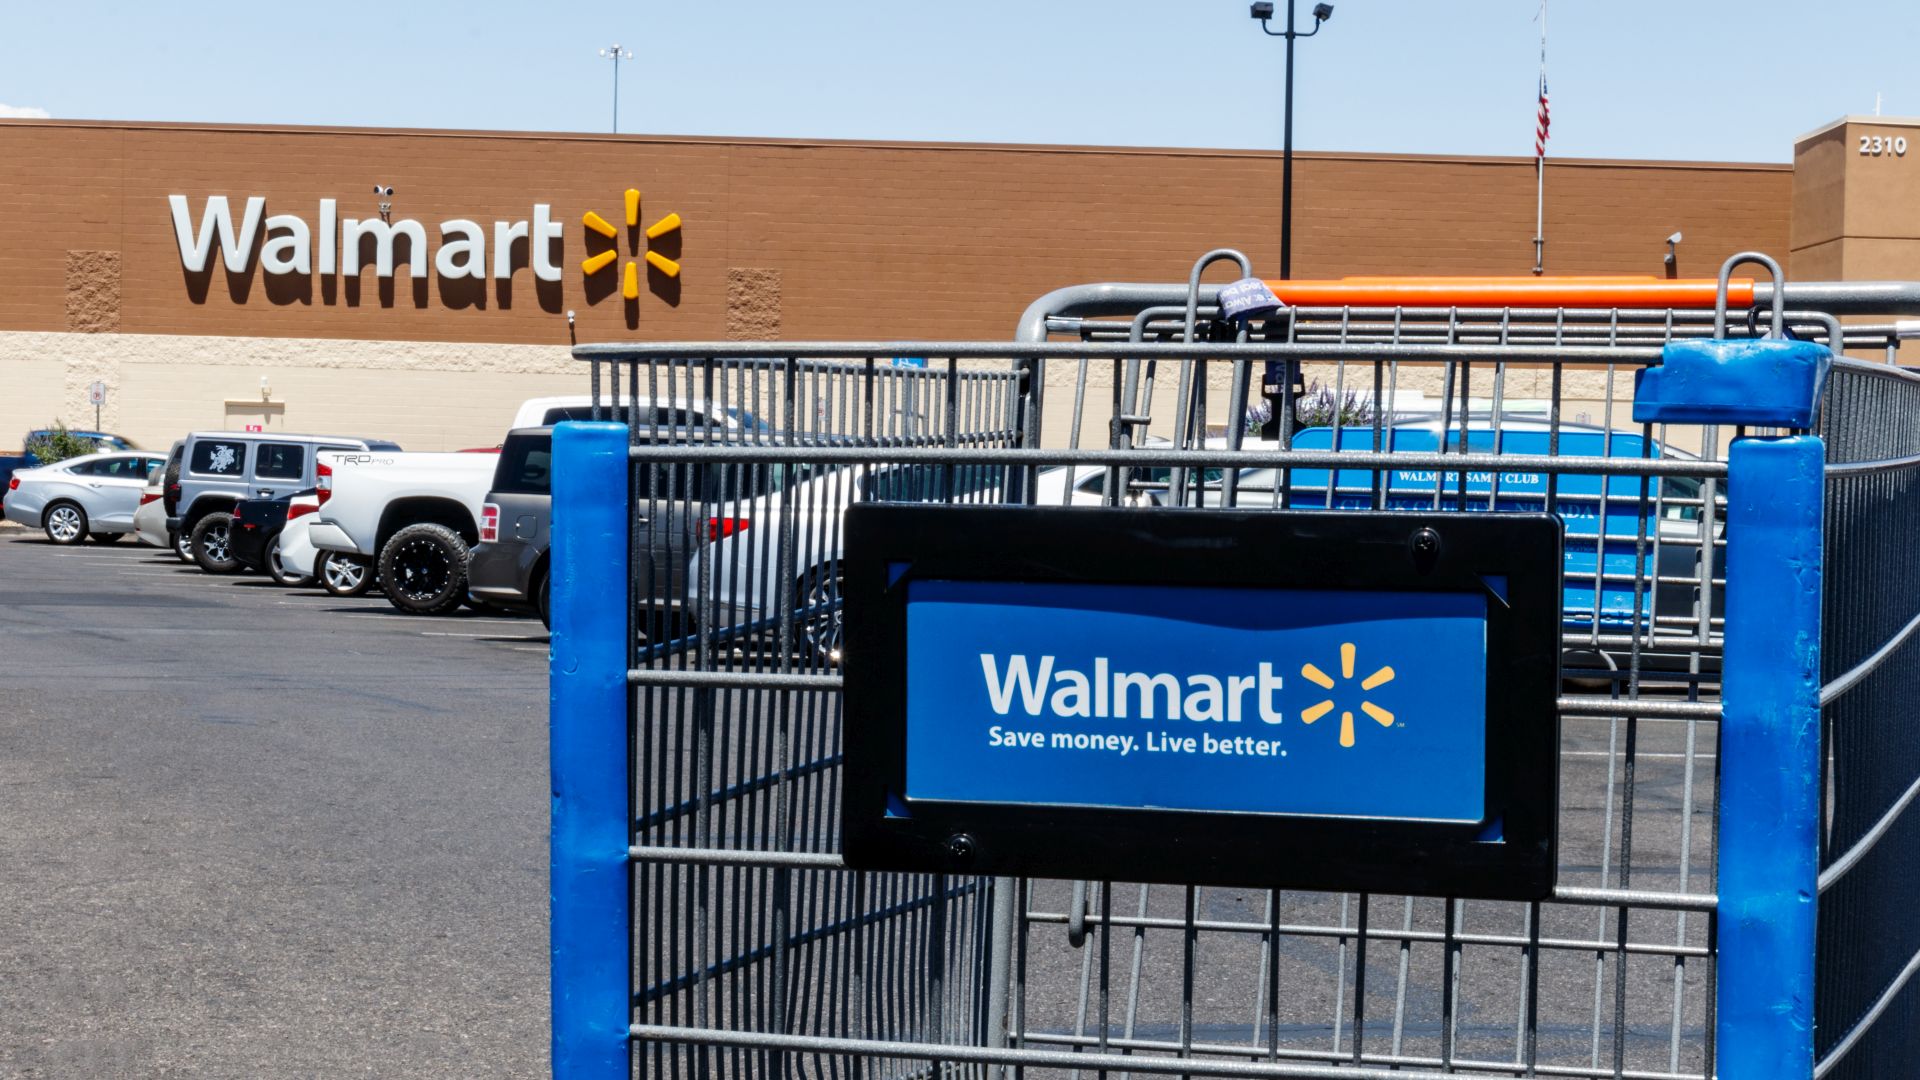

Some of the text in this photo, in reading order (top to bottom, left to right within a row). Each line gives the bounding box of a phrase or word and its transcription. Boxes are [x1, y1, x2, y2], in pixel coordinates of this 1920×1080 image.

[1859, 135, 1907, 153] 2310
[168, 194, 564, 282] Walmart
[332, 454, 371, 466] TRD
[1399, 471, 1461, 482] WALMRT
[1505, 473, 1539, 485] CLUB
[1514, 502, 1595, 519] NEADA
[980, 653, 1283, 725] Walmart
[988, 726, 1288, 757] Save money. Live better.
